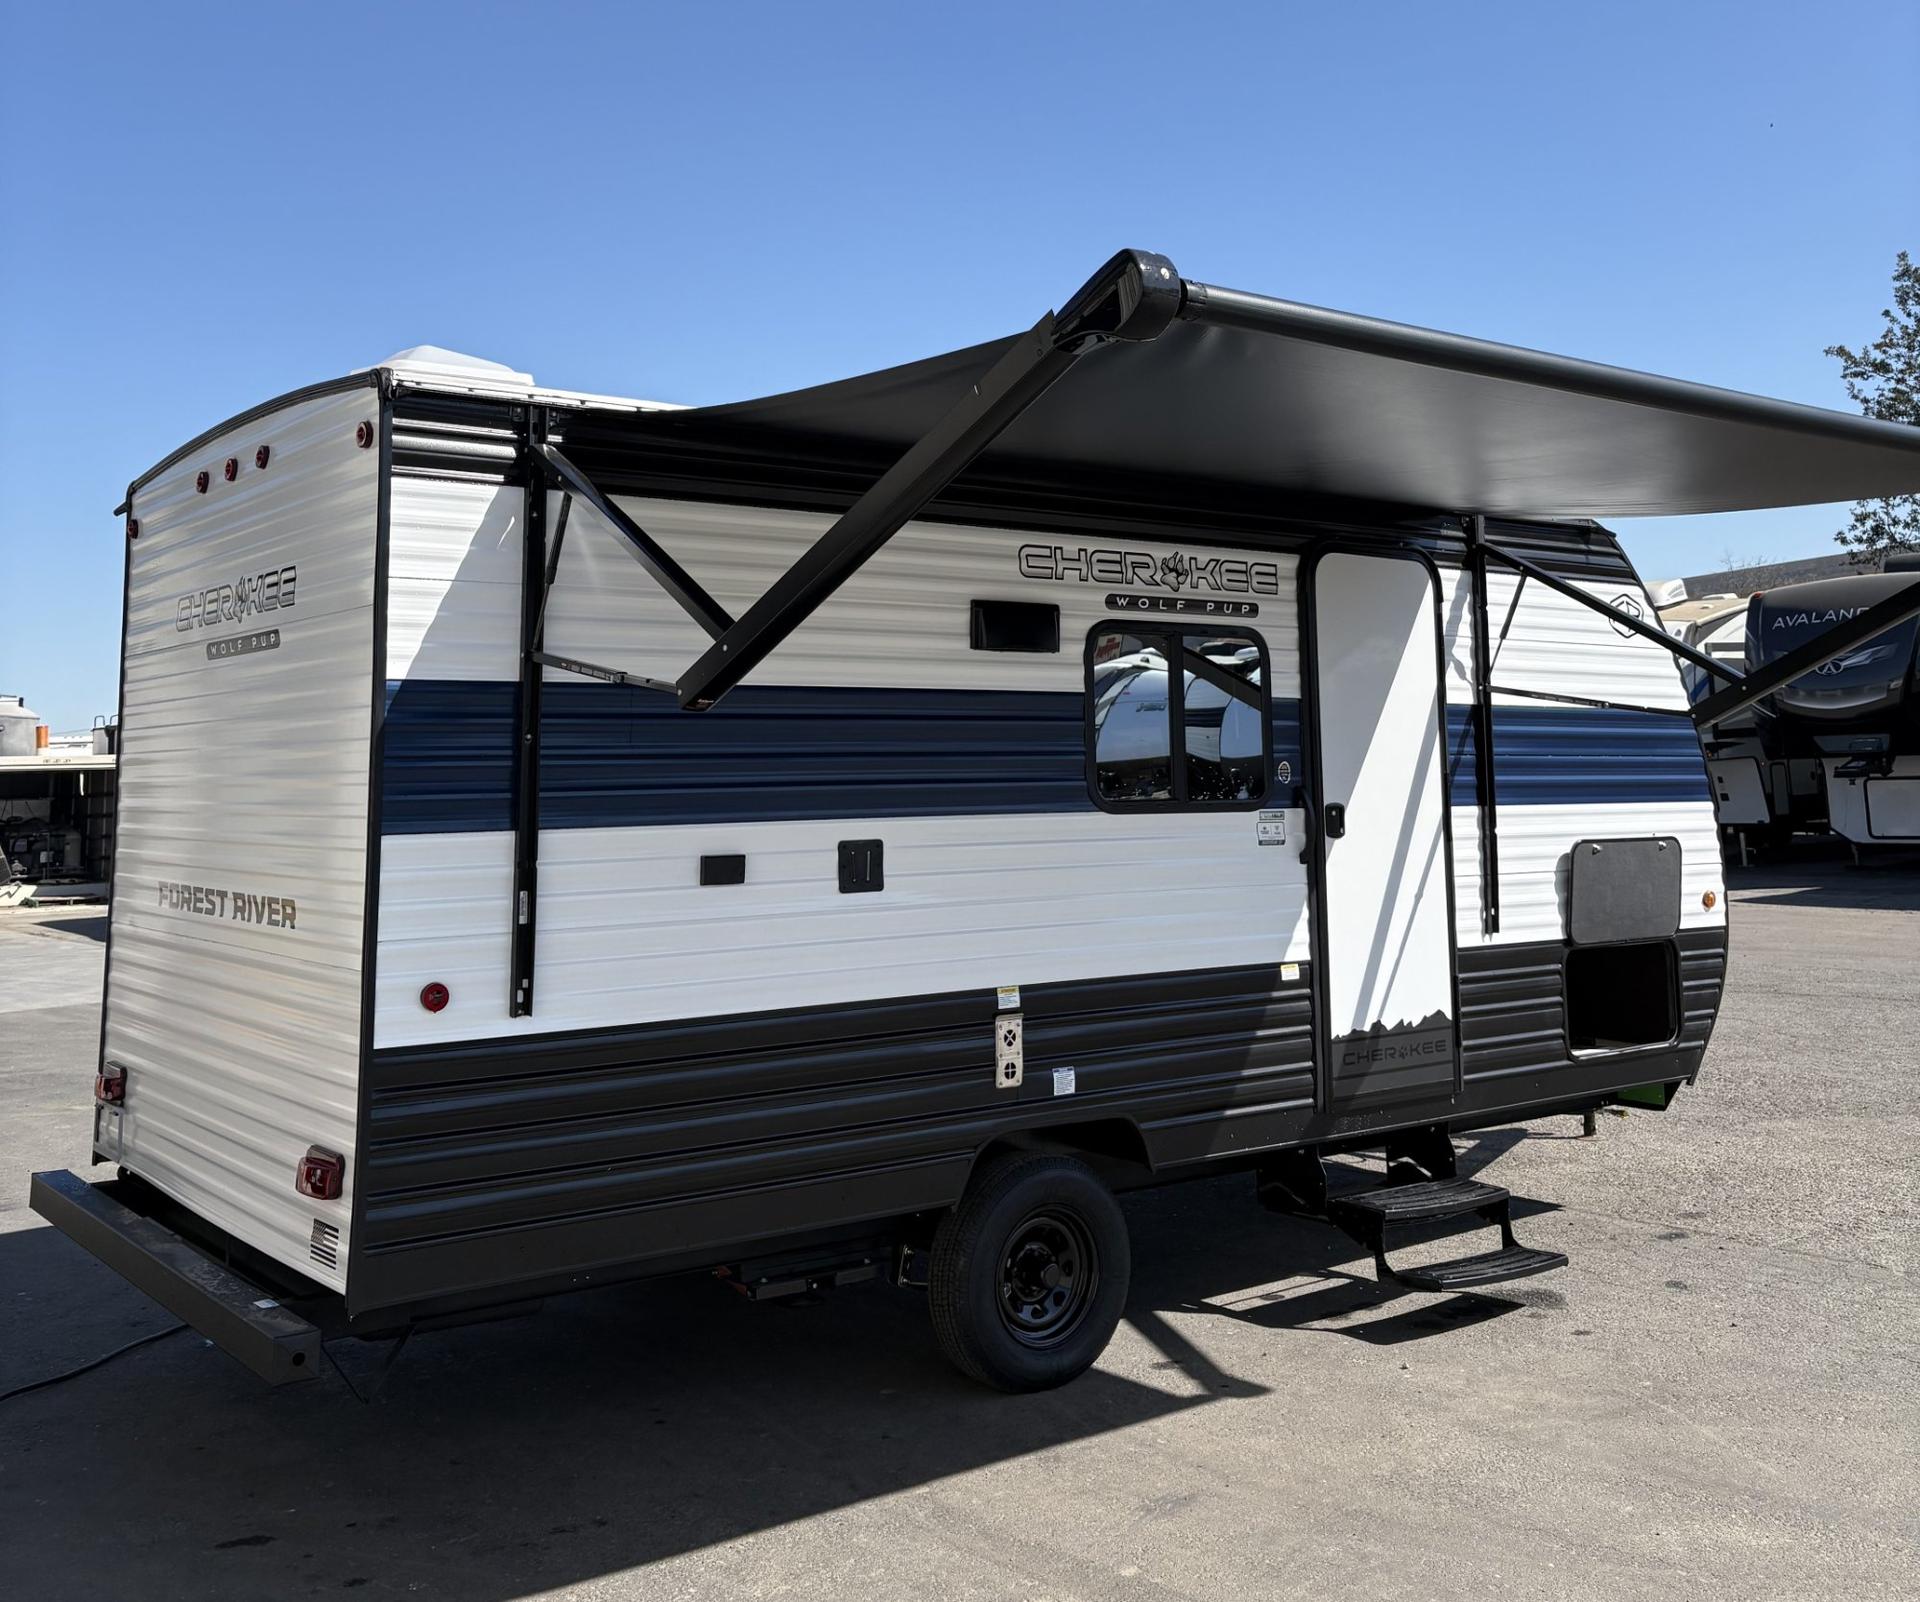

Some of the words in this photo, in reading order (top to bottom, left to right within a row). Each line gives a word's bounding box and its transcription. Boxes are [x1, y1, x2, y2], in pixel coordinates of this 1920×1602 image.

[1018, 543, 1279, 595] CHEROKEE
[175, 564, 297, 633] CHEROKEE
[1116, 596, 1187, 611] WOLF
[1206, 602, 1251, 615] PUP
[1771, 606, 1870, 631] AVALAN
[209, 639, 243, 656] WOLF
[251, 633, 277, 649] PUP
[158, 880, 229, 918] FOREST
[232, 891, 297, 930] RIVER
